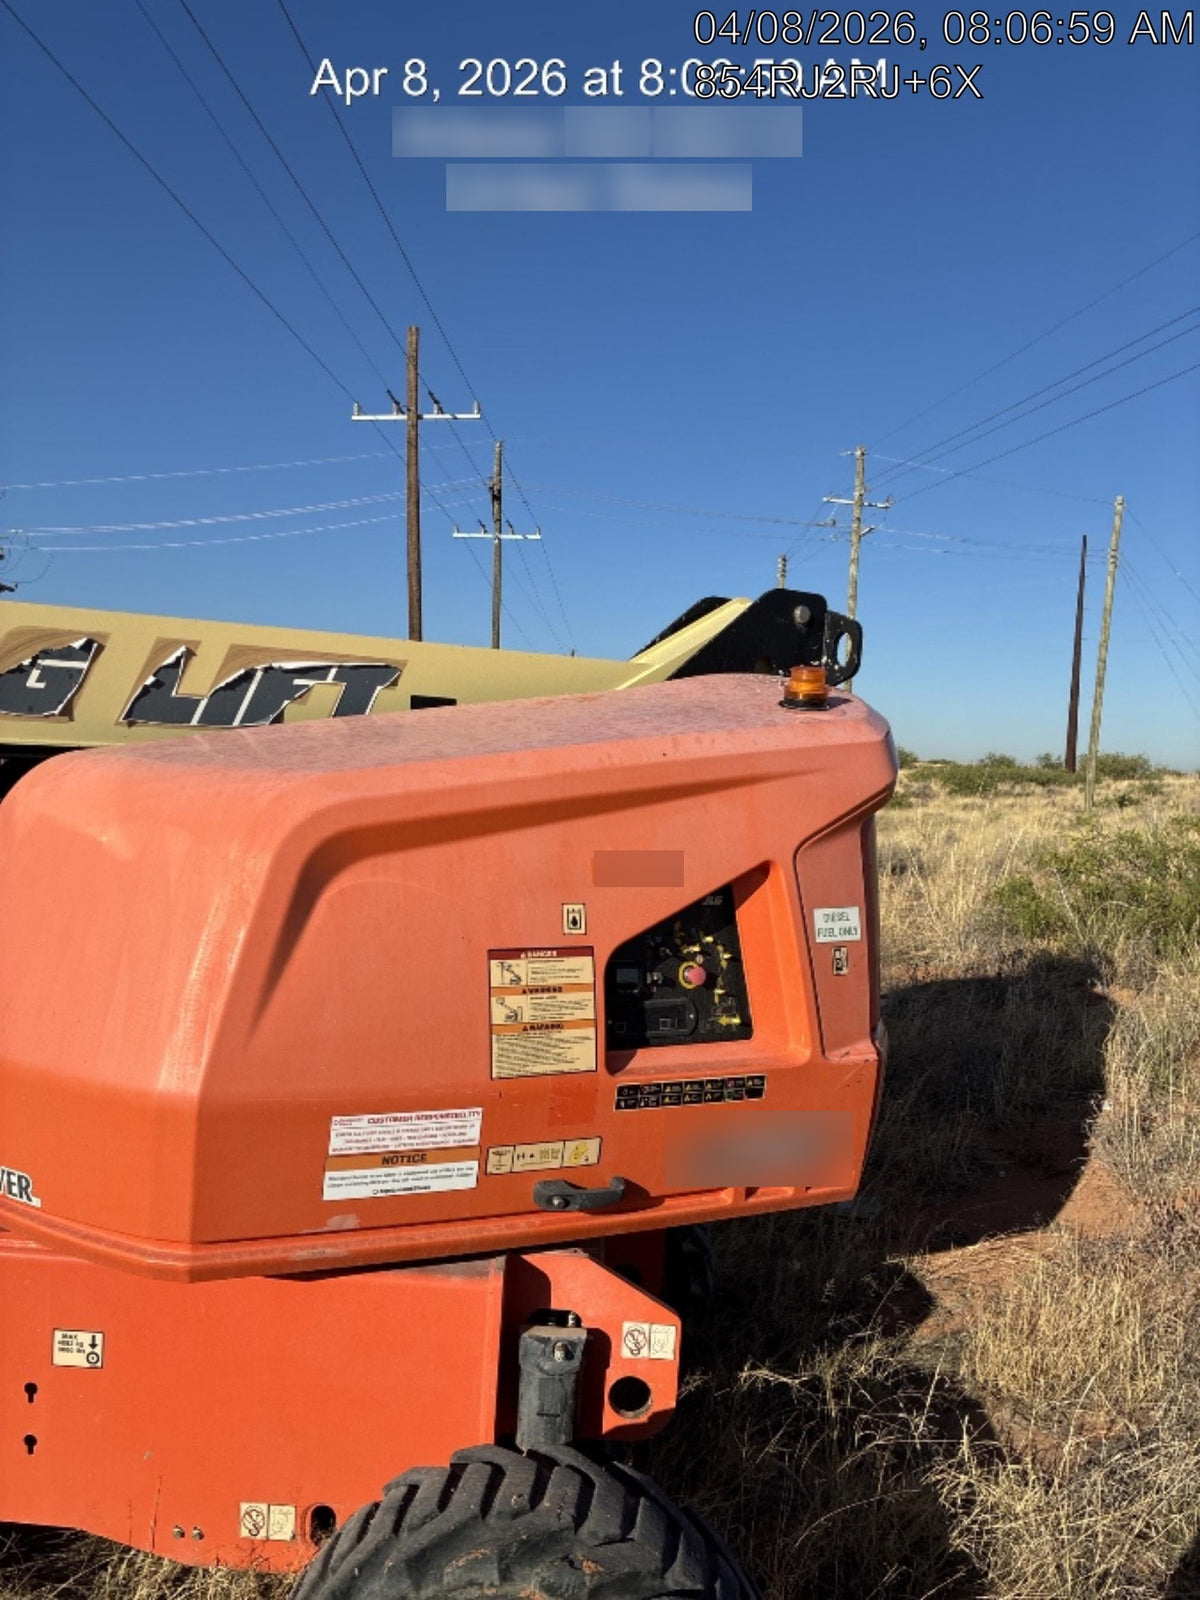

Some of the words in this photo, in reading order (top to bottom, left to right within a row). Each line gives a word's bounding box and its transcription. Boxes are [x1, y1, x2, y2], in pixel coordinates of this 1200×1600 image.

[119, 644, 403, 728] LIFT
[817, 927, 838, 938] FUEL
[838, 925, 858, 938] ONLY
[381, 1153, 428, 1166] NOTICE
